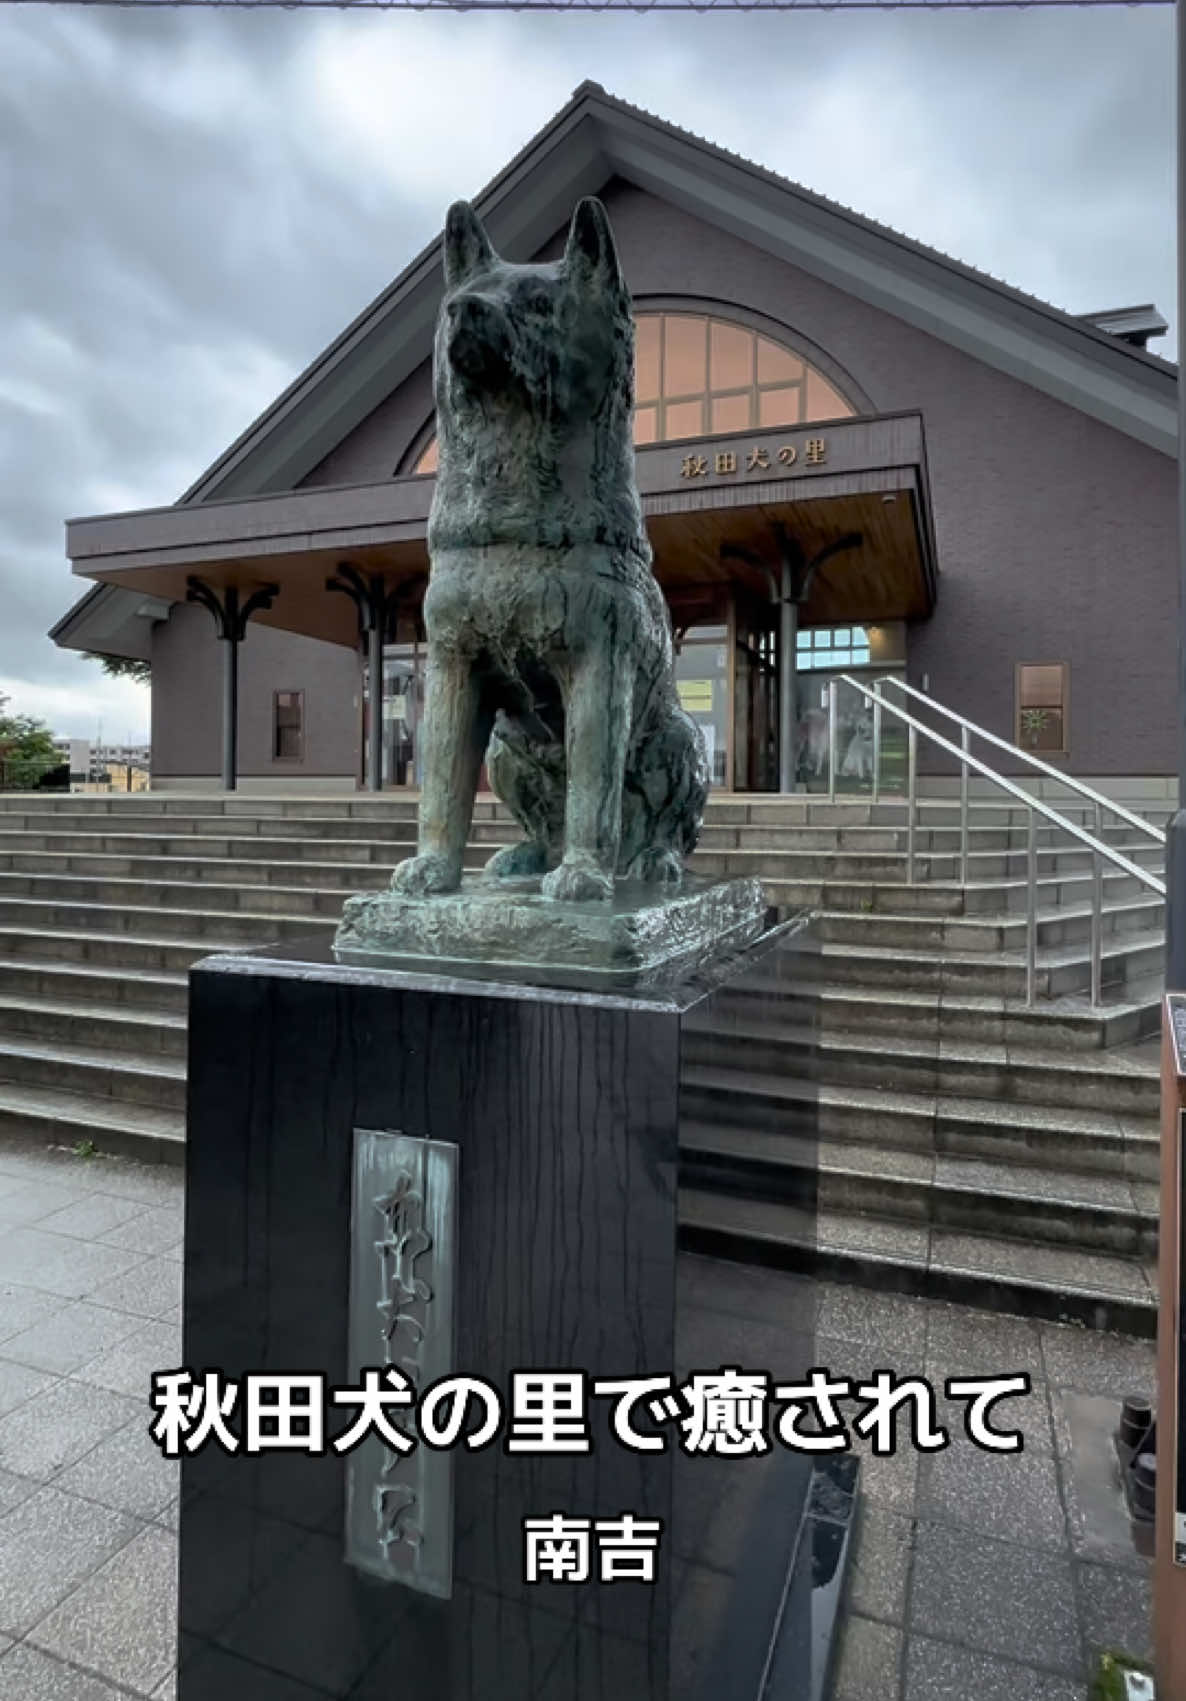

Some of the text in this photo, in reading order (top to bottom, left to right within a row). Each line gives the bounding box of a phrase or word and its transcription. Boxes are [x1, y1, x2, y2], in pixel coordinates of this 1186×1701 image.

[680, 438, 827, 480] 秋田犬の里
